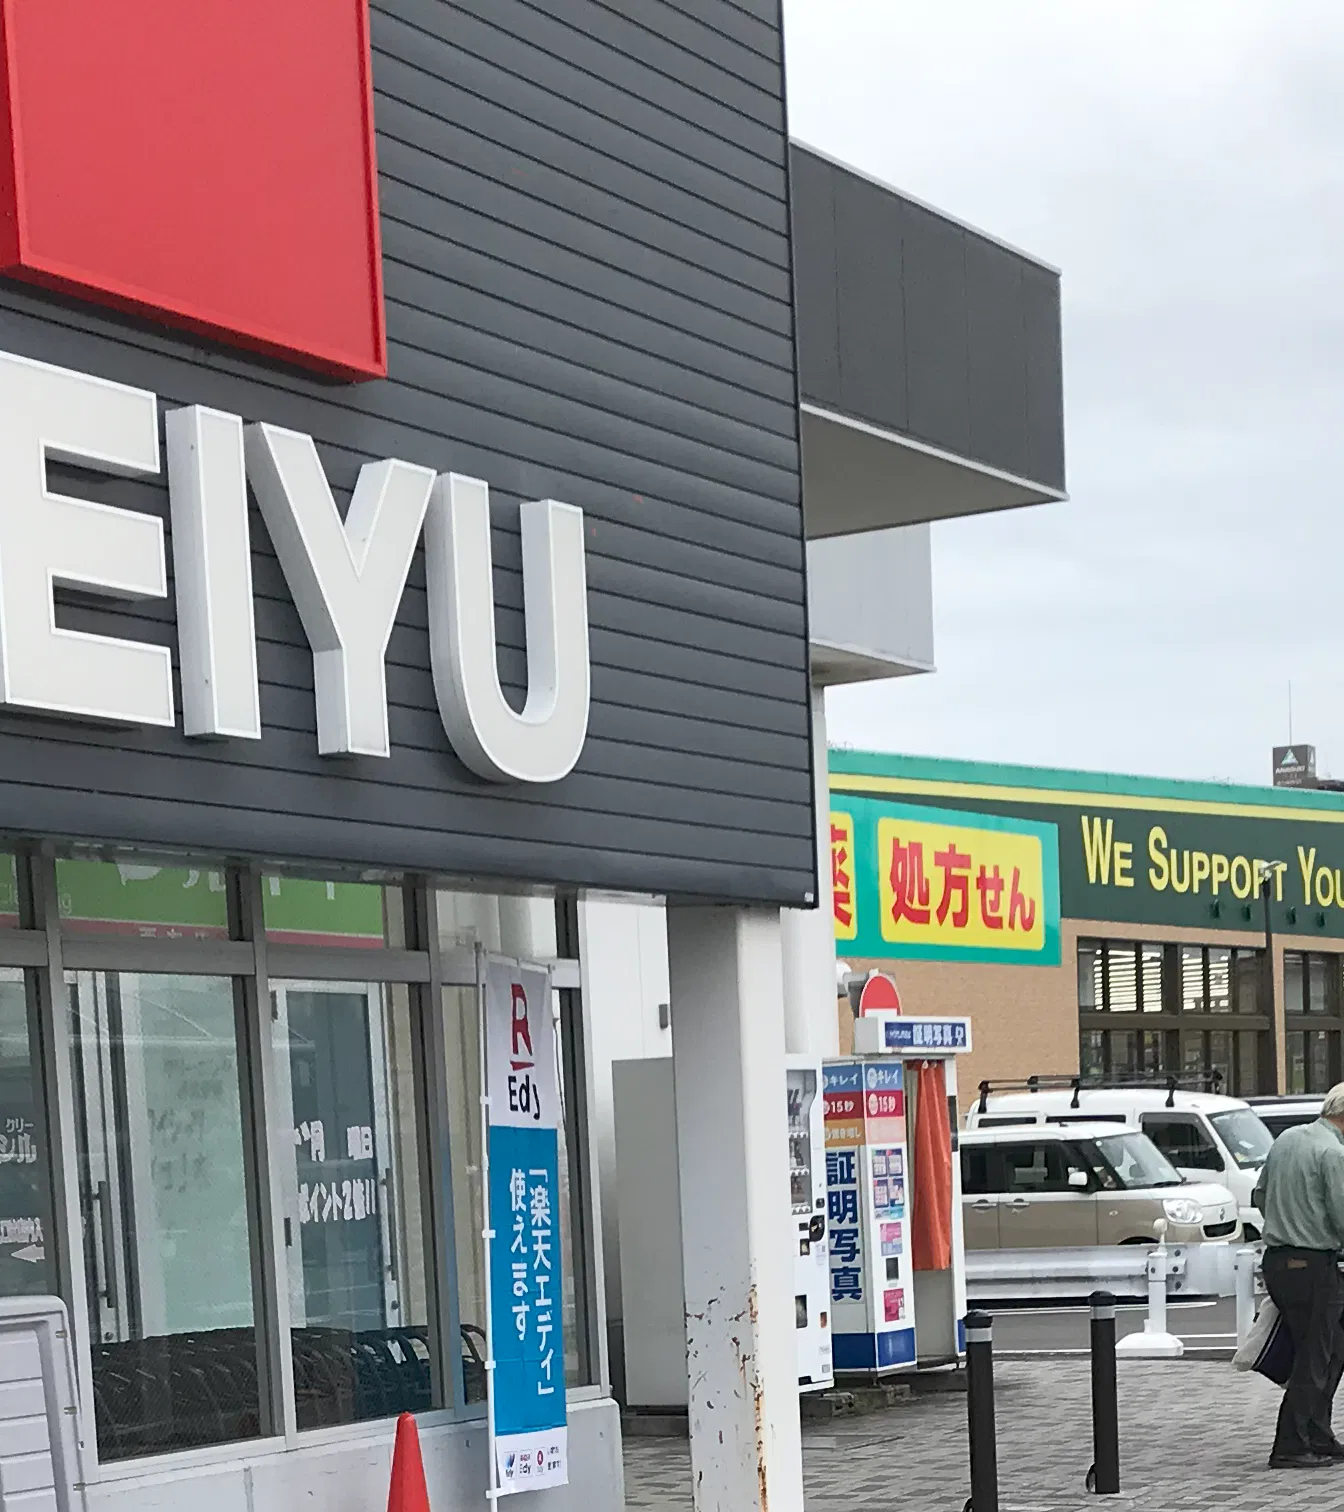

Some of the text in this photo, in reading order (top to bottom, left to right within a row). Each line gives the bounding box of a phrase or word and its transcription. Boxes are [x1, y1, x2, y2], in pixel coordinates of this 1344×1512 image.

[890, 836, 1036, 933] 処方せん
[510, 1168, 531, 1342] 使えます
[825, 1151, 863, 1302] 証明写真
